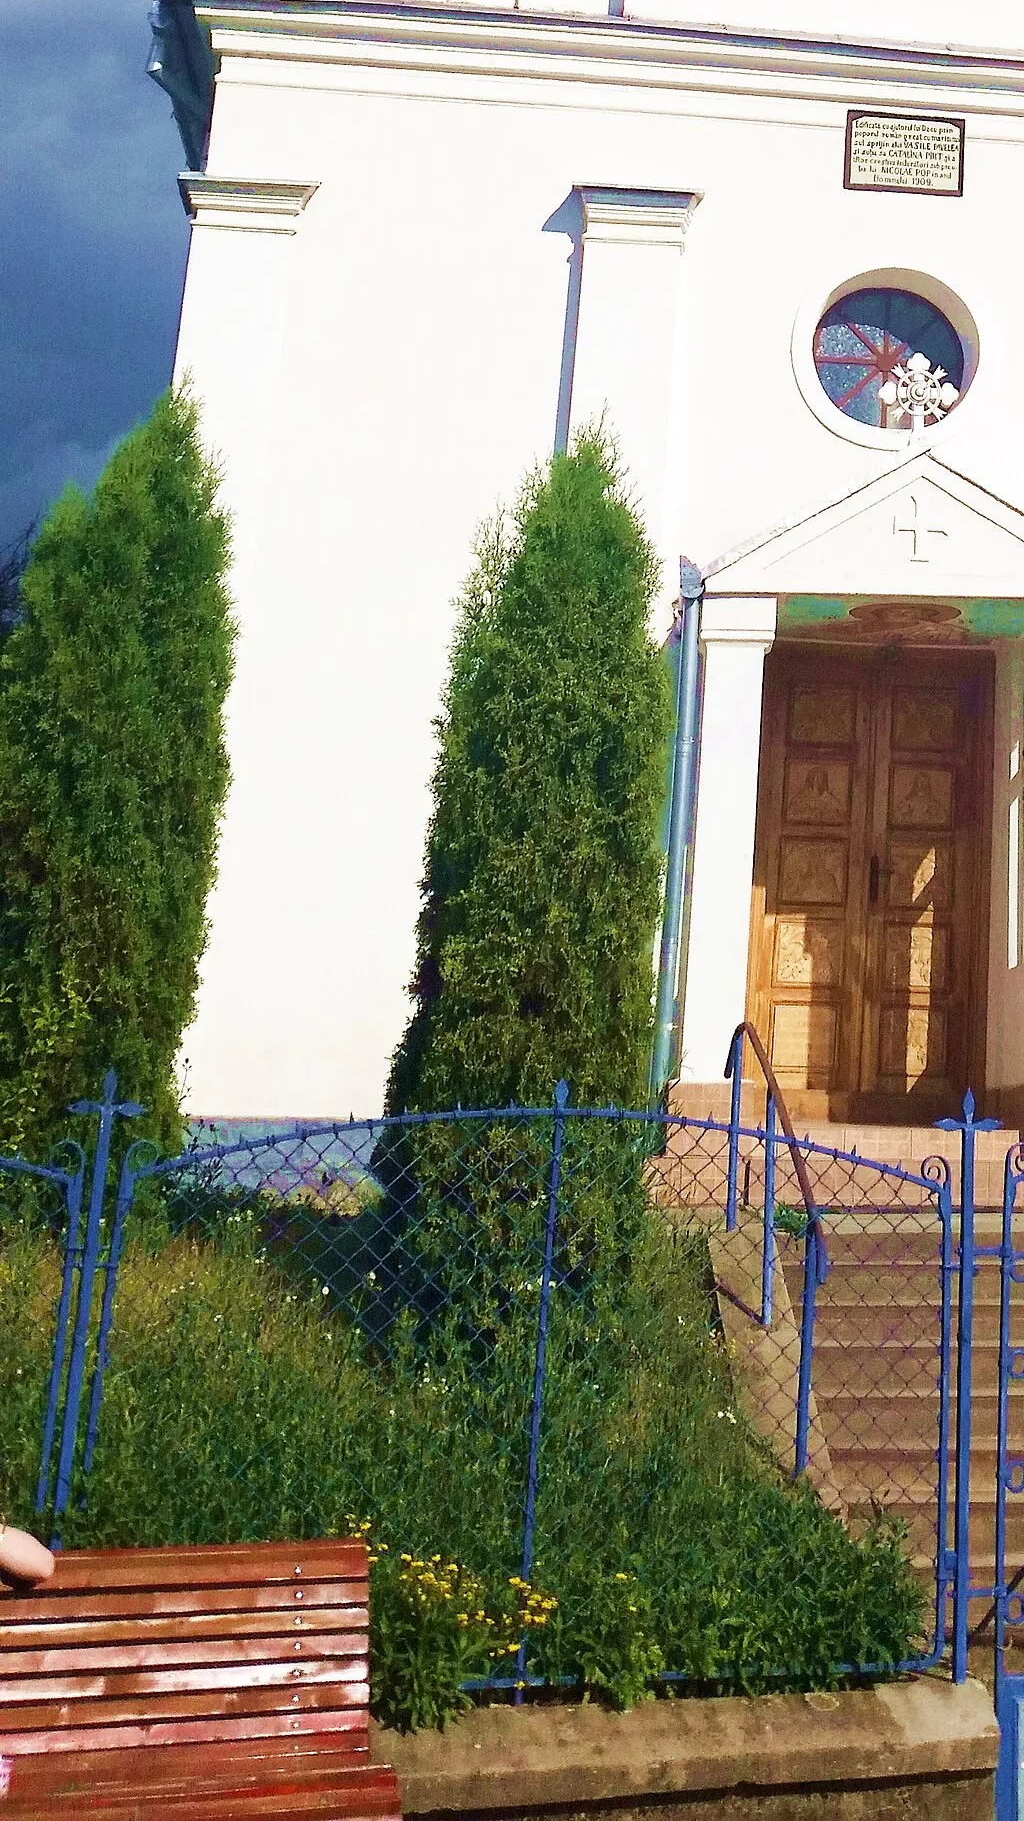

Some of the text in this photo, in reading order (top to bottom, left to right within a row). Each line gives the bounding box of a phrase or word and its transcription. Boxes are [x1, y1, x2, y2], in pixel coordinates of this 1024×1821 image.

[904, 142, 930, 150] VASILE
[881, 167, 912, 176] NICOLAE
[916, 169, 930, 177] POP
